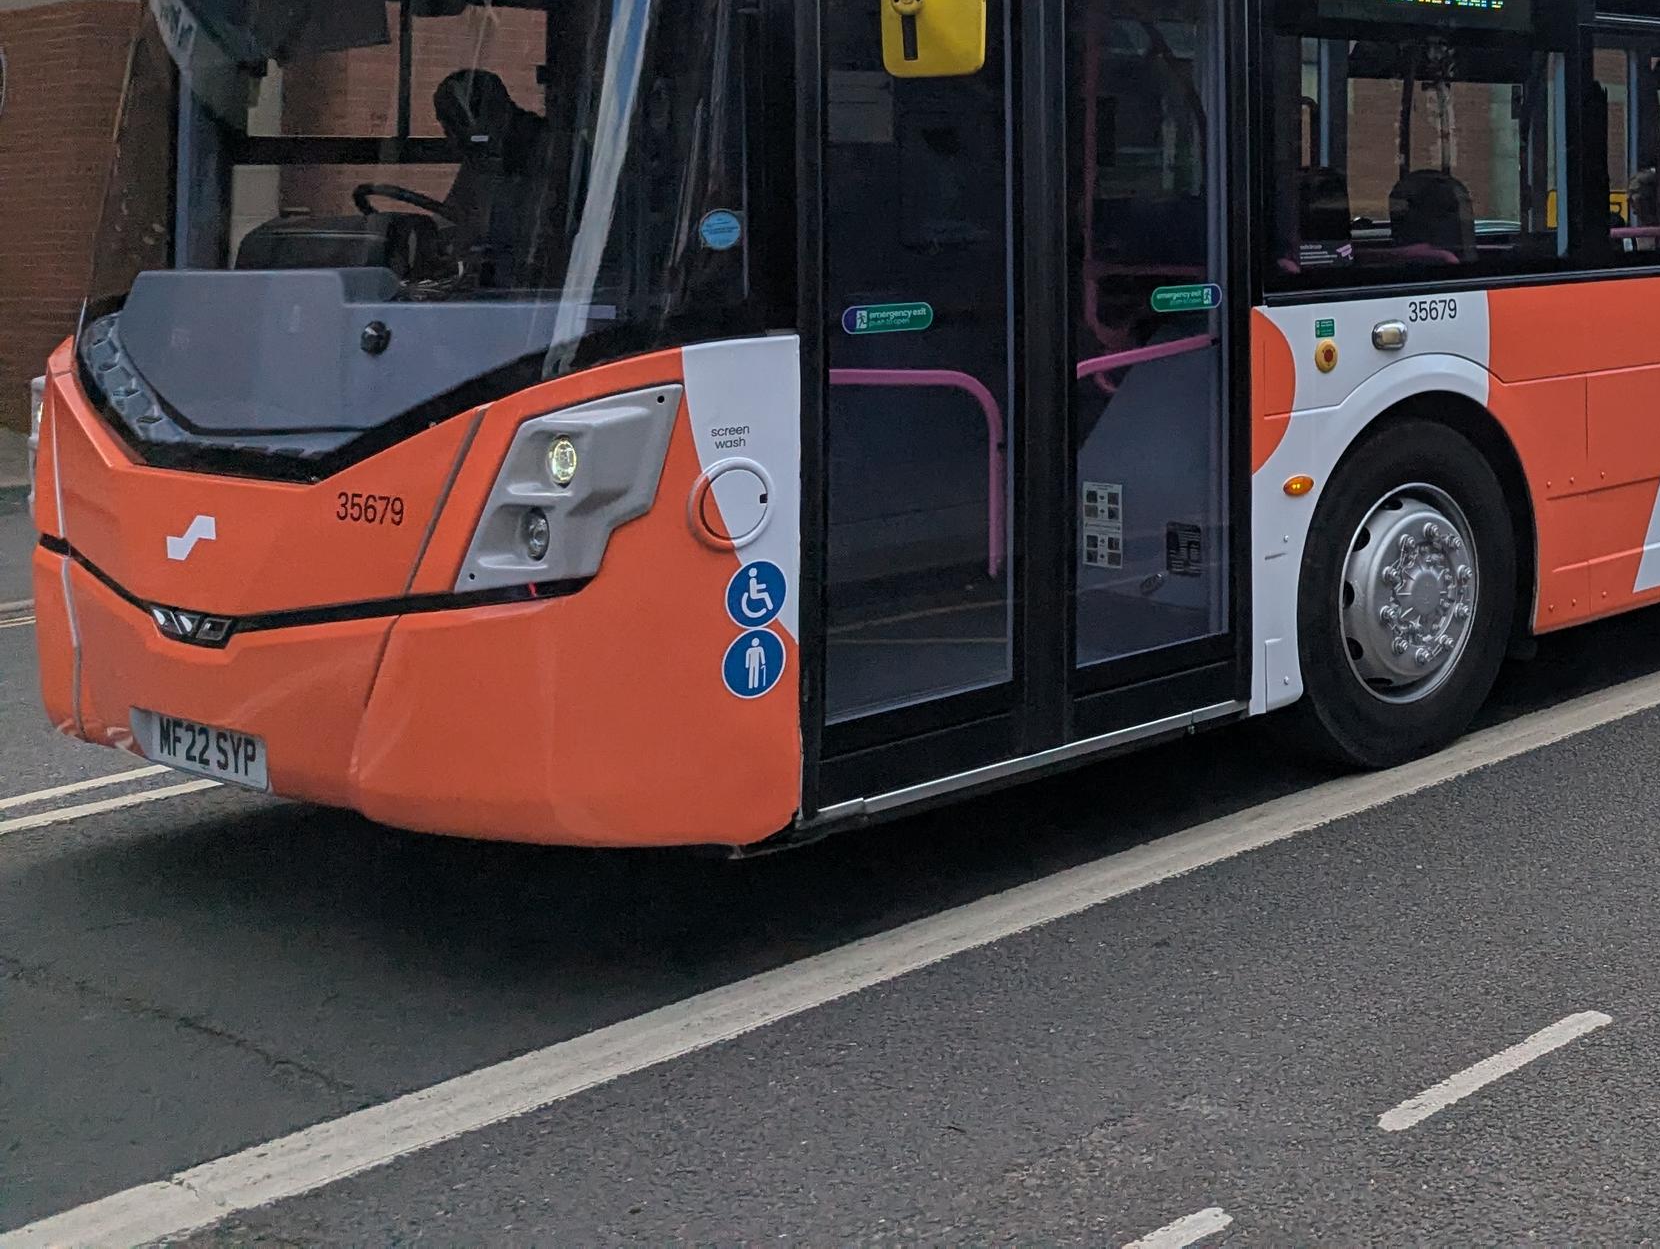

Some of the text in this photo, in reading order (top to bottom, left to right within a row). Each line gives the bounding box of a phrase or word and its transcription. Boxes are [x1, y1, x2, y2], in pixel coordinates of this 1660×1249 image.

[869, 307, 926, 320] emergency exit
[1408, 298, 1457, 323] 35679
[710, 424, 750, 438] screen
[714, 437, 746, 449] wash
[336, 491, 404, 526] 35679
[159, 716, 257, 777] MF22 SYP
